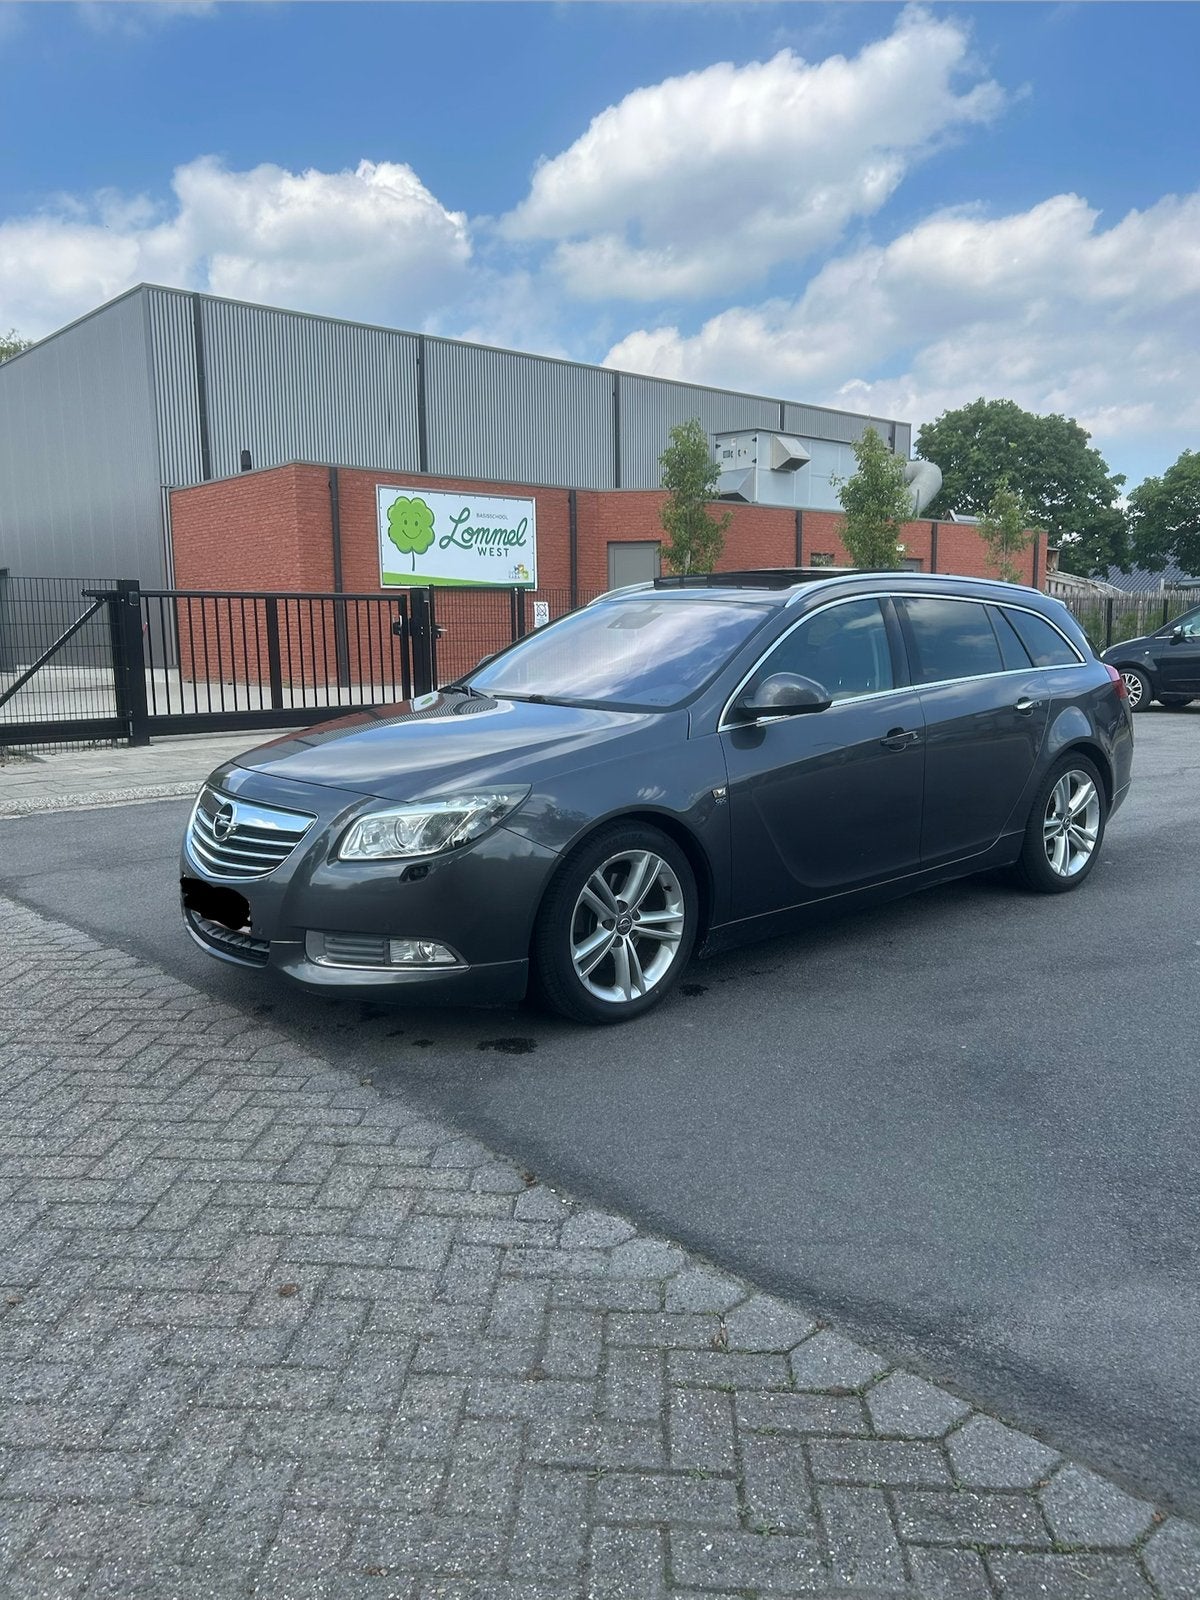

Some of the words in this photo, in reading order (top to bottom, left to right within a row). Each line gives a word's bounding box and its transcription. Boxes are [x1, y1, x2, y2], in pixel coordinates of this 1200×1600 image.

[476, 512, 508, 520] BASISSCHOOL
[439, 507, 528, 549] Lommel
[477, 546, 510, 557] WEST
